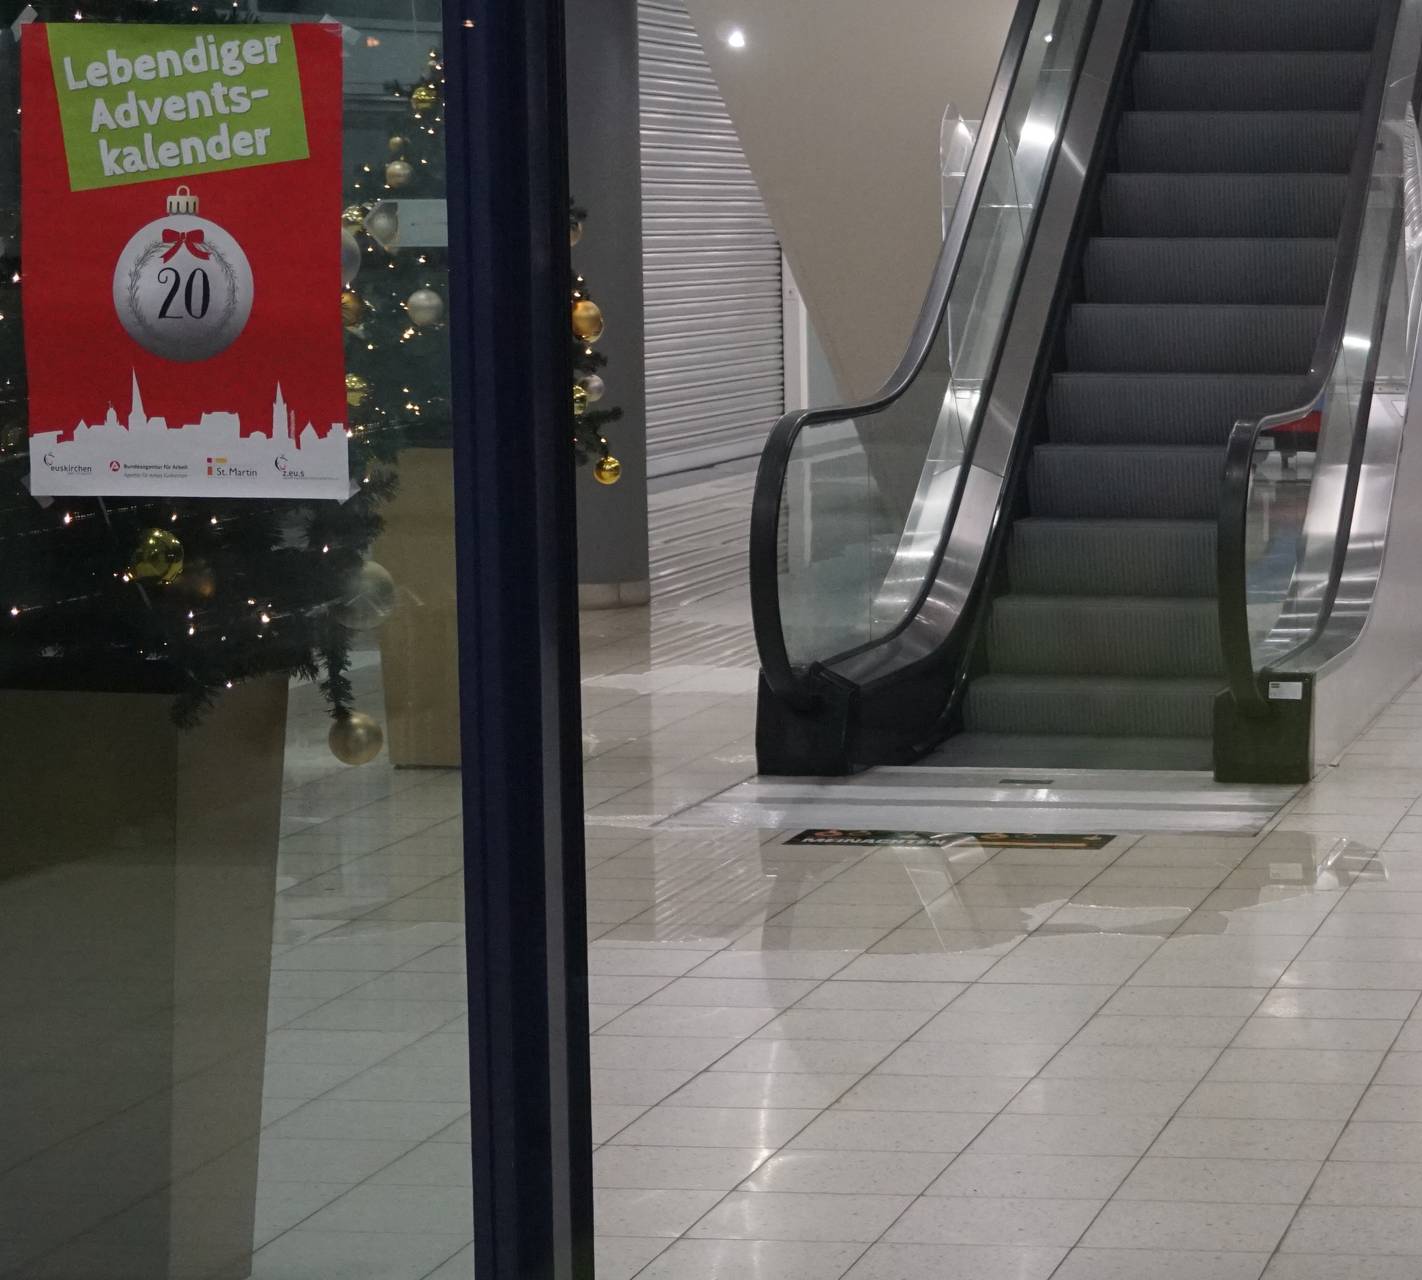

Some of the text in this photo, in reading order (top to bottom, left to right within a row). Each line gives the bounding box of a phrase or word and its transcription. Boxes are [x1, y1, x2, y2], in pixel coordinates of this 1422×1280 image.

[63, 34, 281, 91] Lebendiger
[90, 81, 269, 133] Advents-
[98, 122, 272, 177] kalender
[157, 266, 211, 320] 20
[50, 463, 92, 473] euskirchen
[229, 467, 258, 477] Martin
